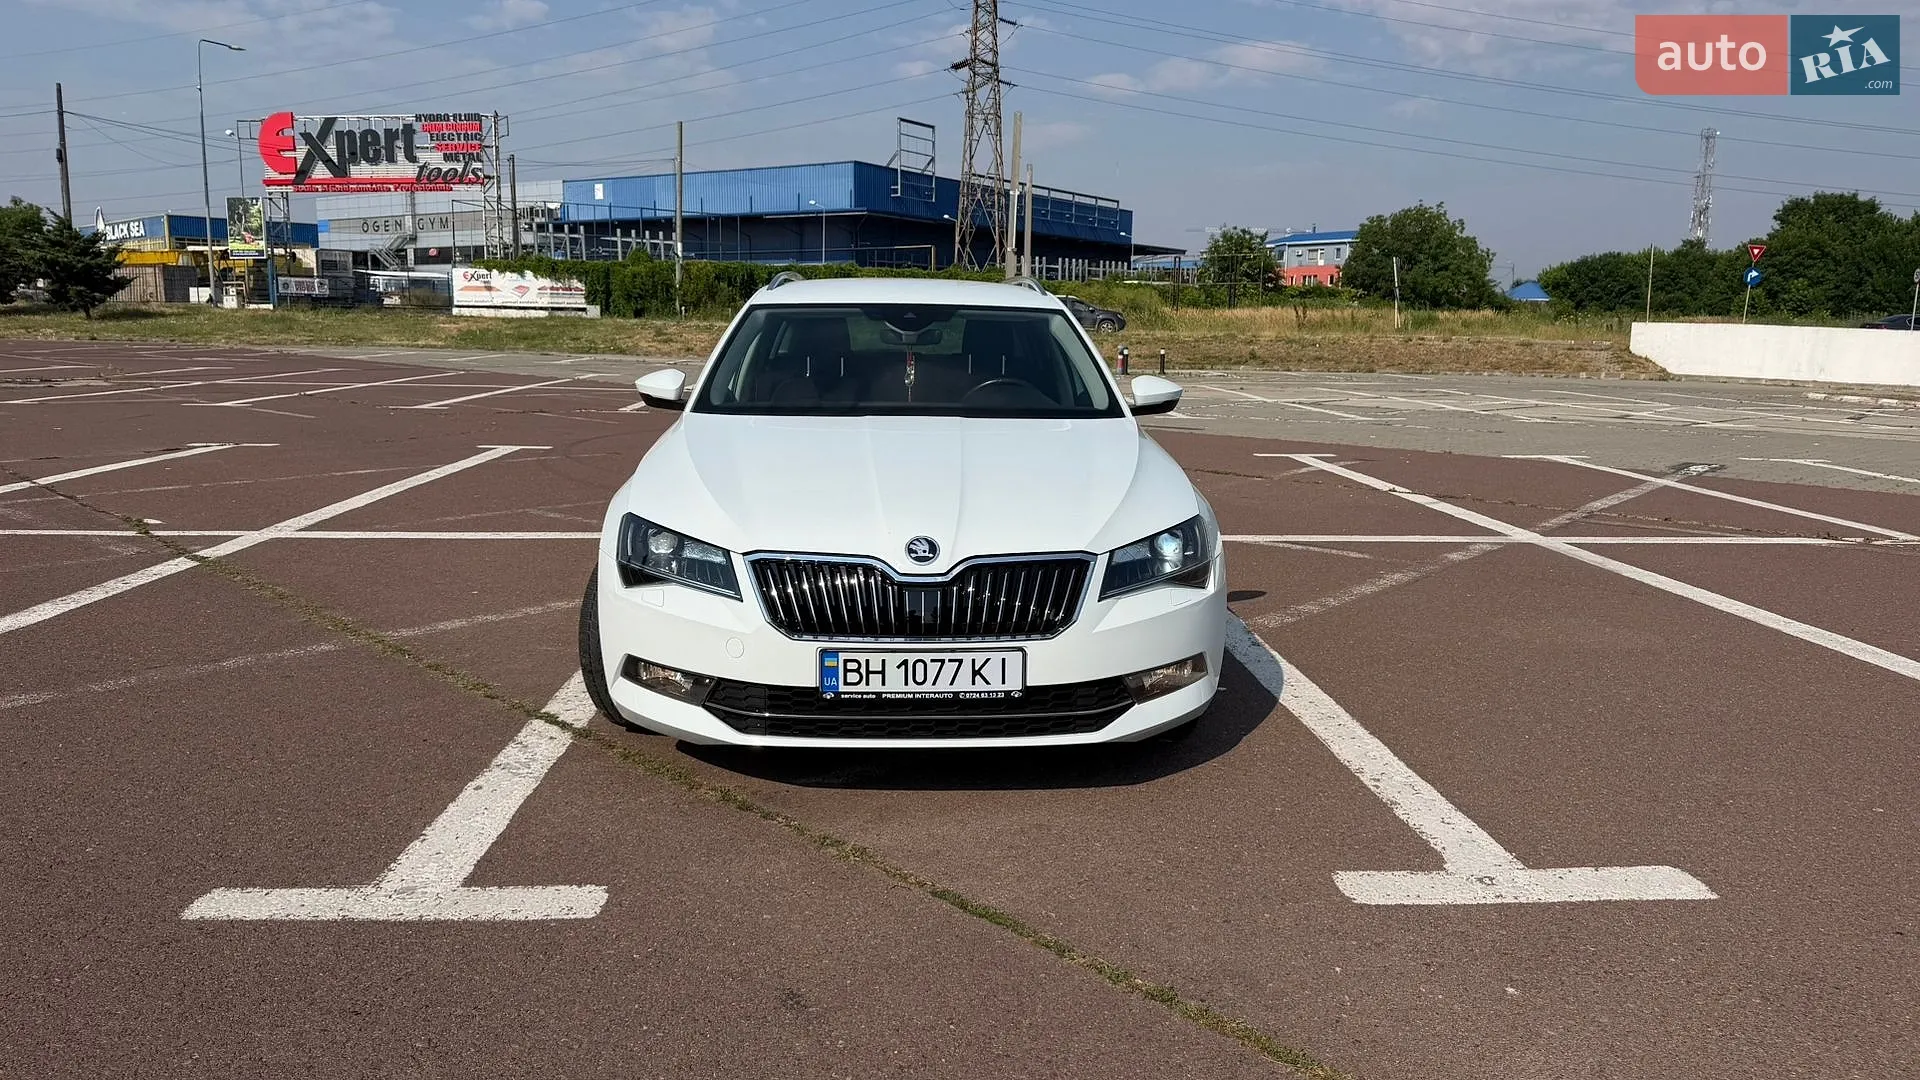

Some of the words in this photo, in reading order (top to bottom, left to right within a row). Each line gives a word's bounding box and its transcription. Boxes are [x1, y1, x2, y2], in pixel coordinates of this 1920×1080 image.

[415, 113, 449, 122] HYDRO
[430, 132, 482, 142] ELECTRIC
[435, 143, 482, 152] SERVICE
[443, 152, 482, 163] METAL
[416, 160, 483, 184] tools
[417, 216, 449, 231] GYM
[106, 222, 130, 241] BLACK
[130, 220, 145, 237] SEA
[843, 658, 886, 687] BH
[895, 658, 964, 687] 1077
[824, 677, 838, 686] UA
